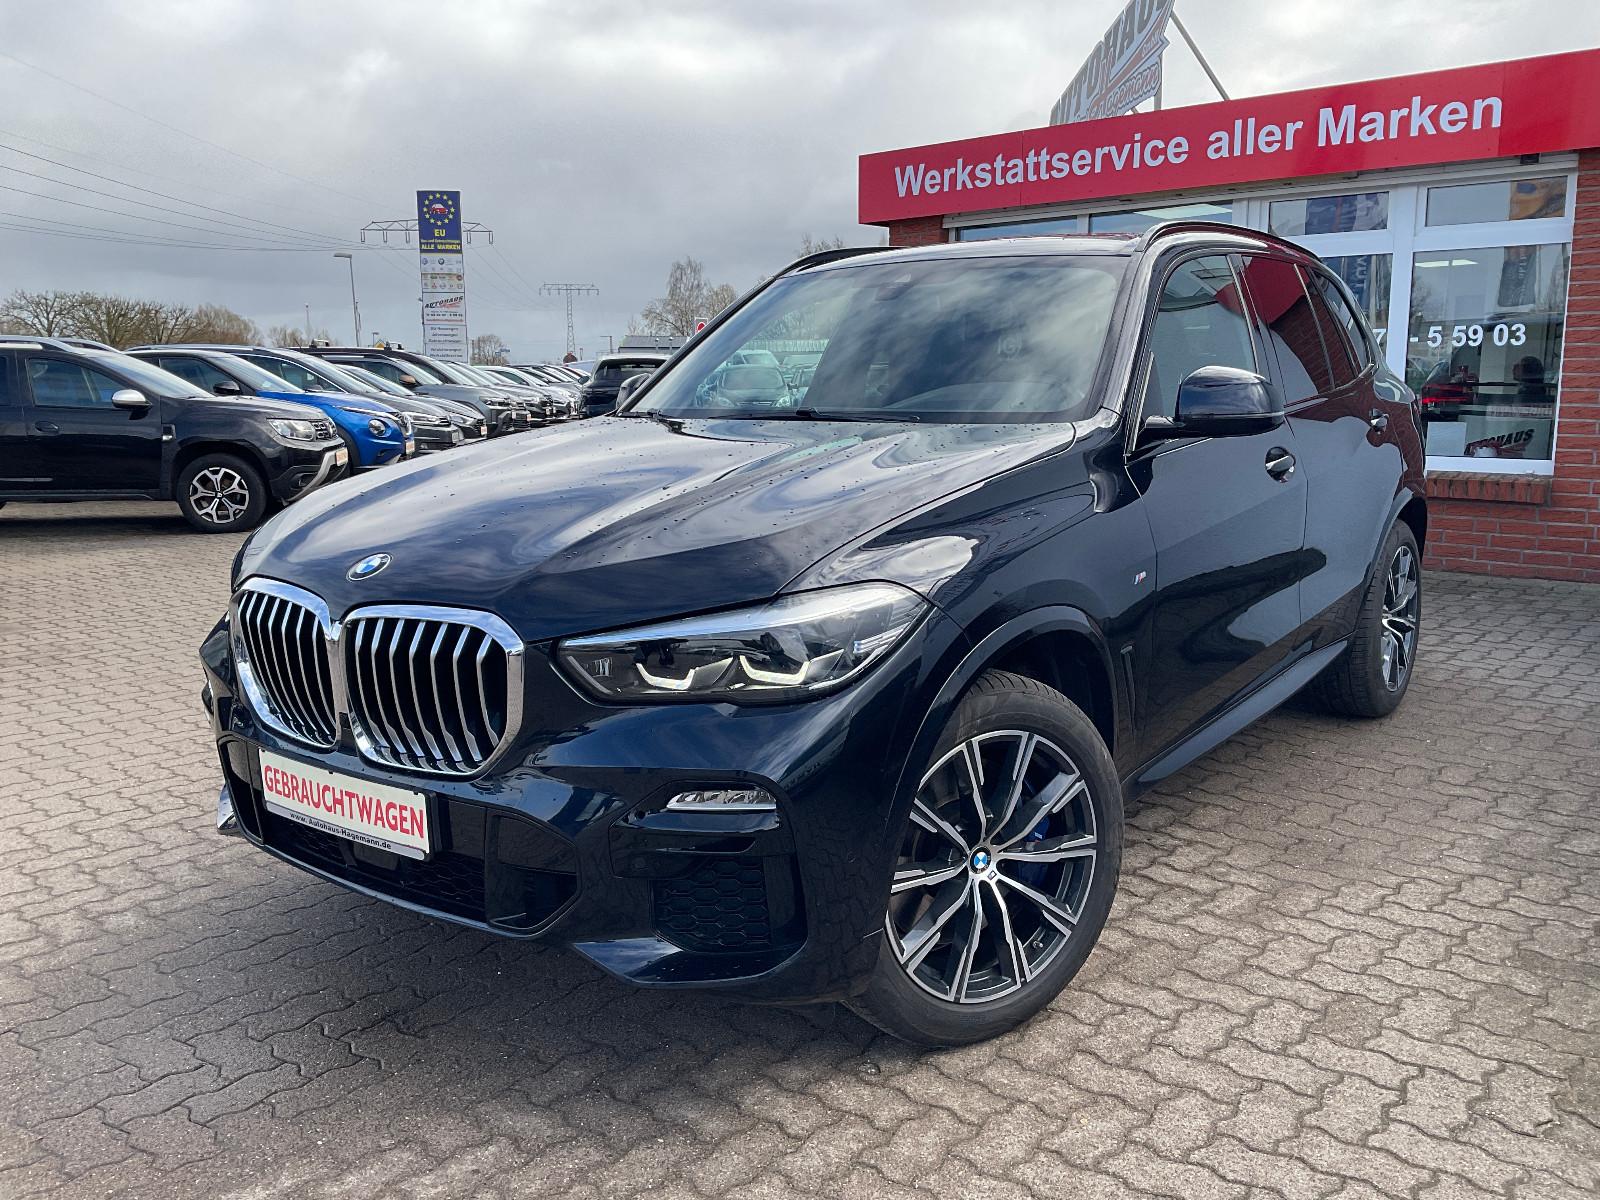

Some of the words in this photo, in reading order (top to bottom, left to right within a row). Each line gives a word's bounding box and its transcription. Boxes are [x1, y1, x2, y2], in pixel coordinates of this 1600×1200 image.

[1049, 0, 1168, 126] UTOHAU
[894, 132, 1189, 197] Werkstattservice
[1206, 117, 1303, 160] aller
[1317, 95, 1503, 147] Marken
[434, 228, 446, 237] EU
[1427, 325, 1443, 348] 5
[1452, 324, 1484, 347] 59
[1493, 323, 1527, 346] 03
[263, 764, 425, 839] GEBRAUCHTWAGEN
